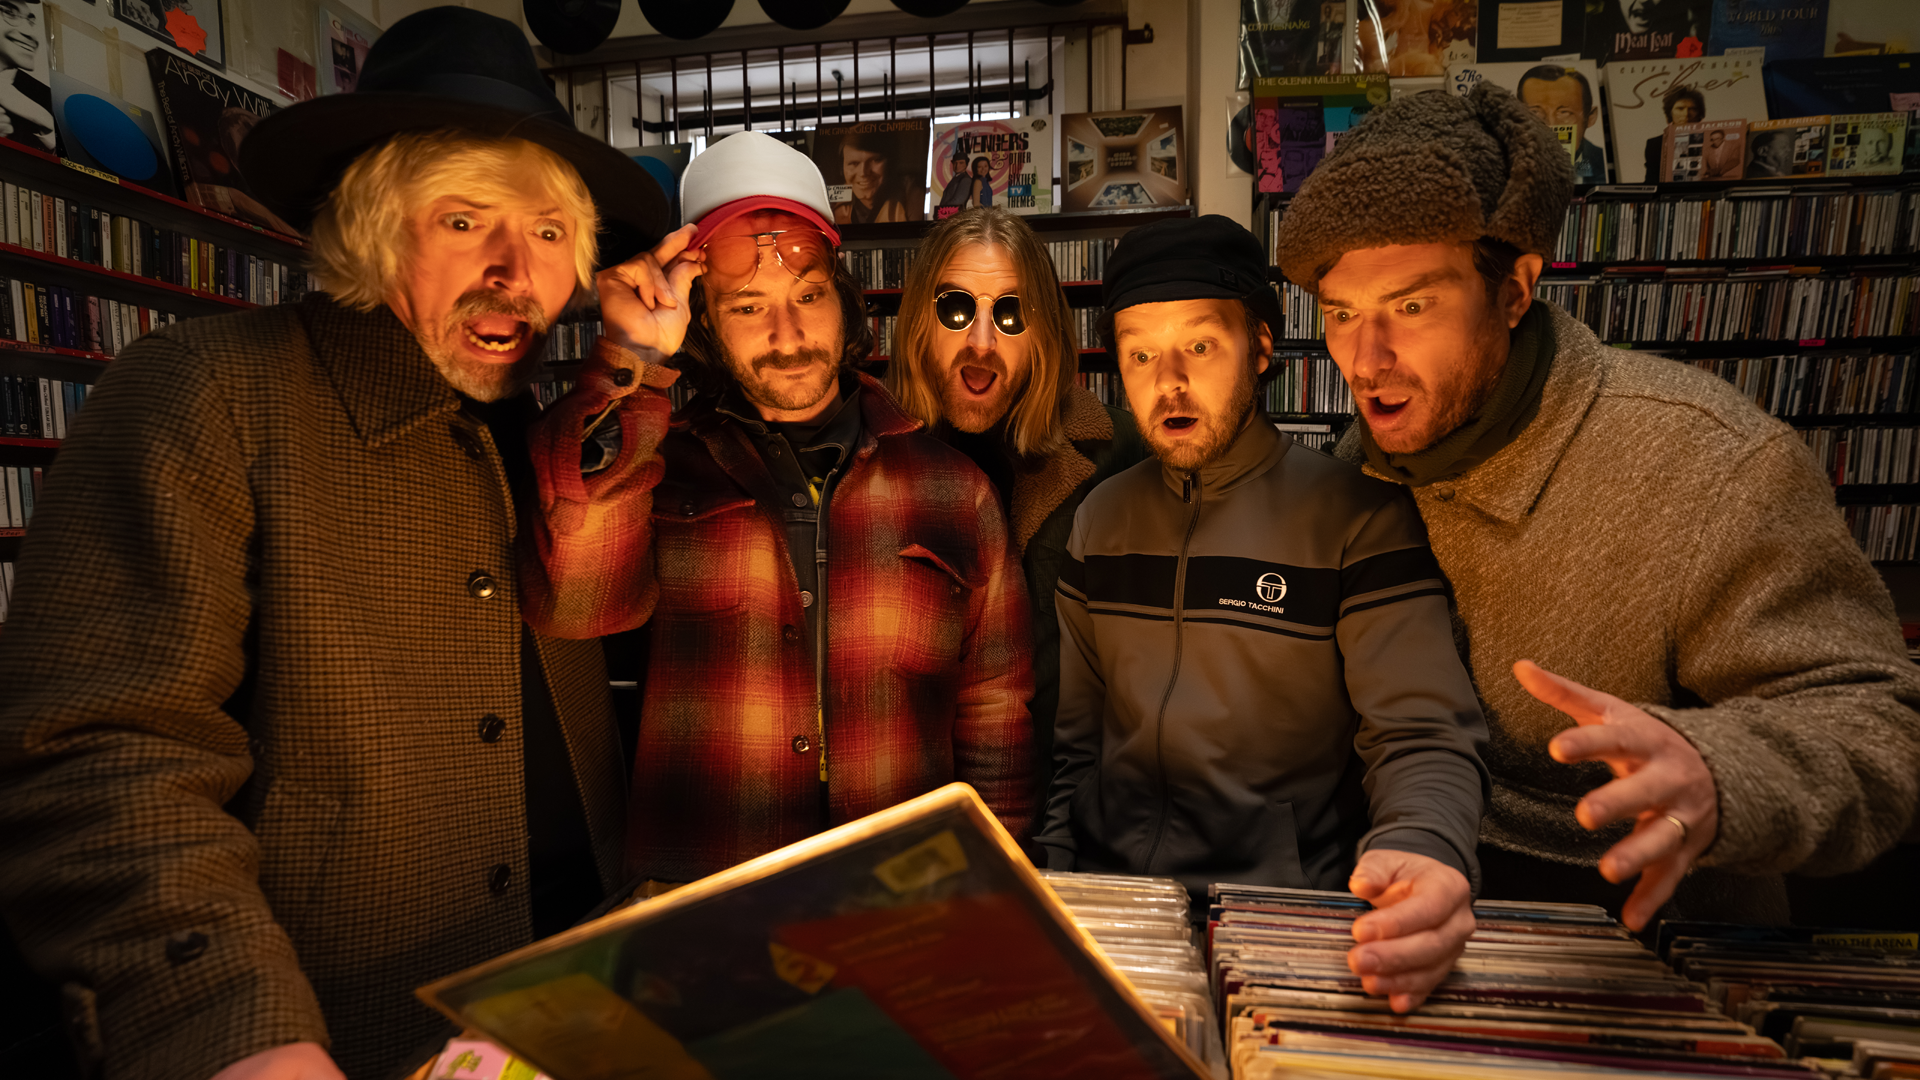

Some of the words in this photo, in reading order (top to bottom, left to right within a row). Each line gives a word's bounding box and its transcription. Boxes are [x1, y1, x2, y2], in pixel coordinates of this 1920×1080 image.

[1728, 10, 1776, 24] WORLD
[1781, 8, 1818, 20] TOUR
[1620, 66, 1667, 74] CLIFF
[165, 55, 230, 107] Andy
[1258, 78, 1277, 87] THE
[1278, 77, 1312, 86] GLENN
[1314, 76, 1349, 85] MILLER
[1352, 74, 1386, 83] YEARS
[1613, 61, 1749, 109] Silver
[161, 96, 172, 115] Best
[170, 125, 180, 146] Andy
[854, 122, 877, 133] GLEN
[879, 120, 925, 133] CAMPBELL
[956, 133, 1029, 154] AVENGERS
[1009, 152, 1031, 165] OTHER
[1008, 173, 1036, 186] SIXTIES
[1008, 196, 1035, 208] THEMES
[1218, 597, 1247, 607] SERGIO
[1247, 601, 1284, 614] TACCHINI
[1816, 937, 1847, 947] INTO
[1849, 937, 1871, 947] THE
[1873, 938, 1913, 948] ARENA
